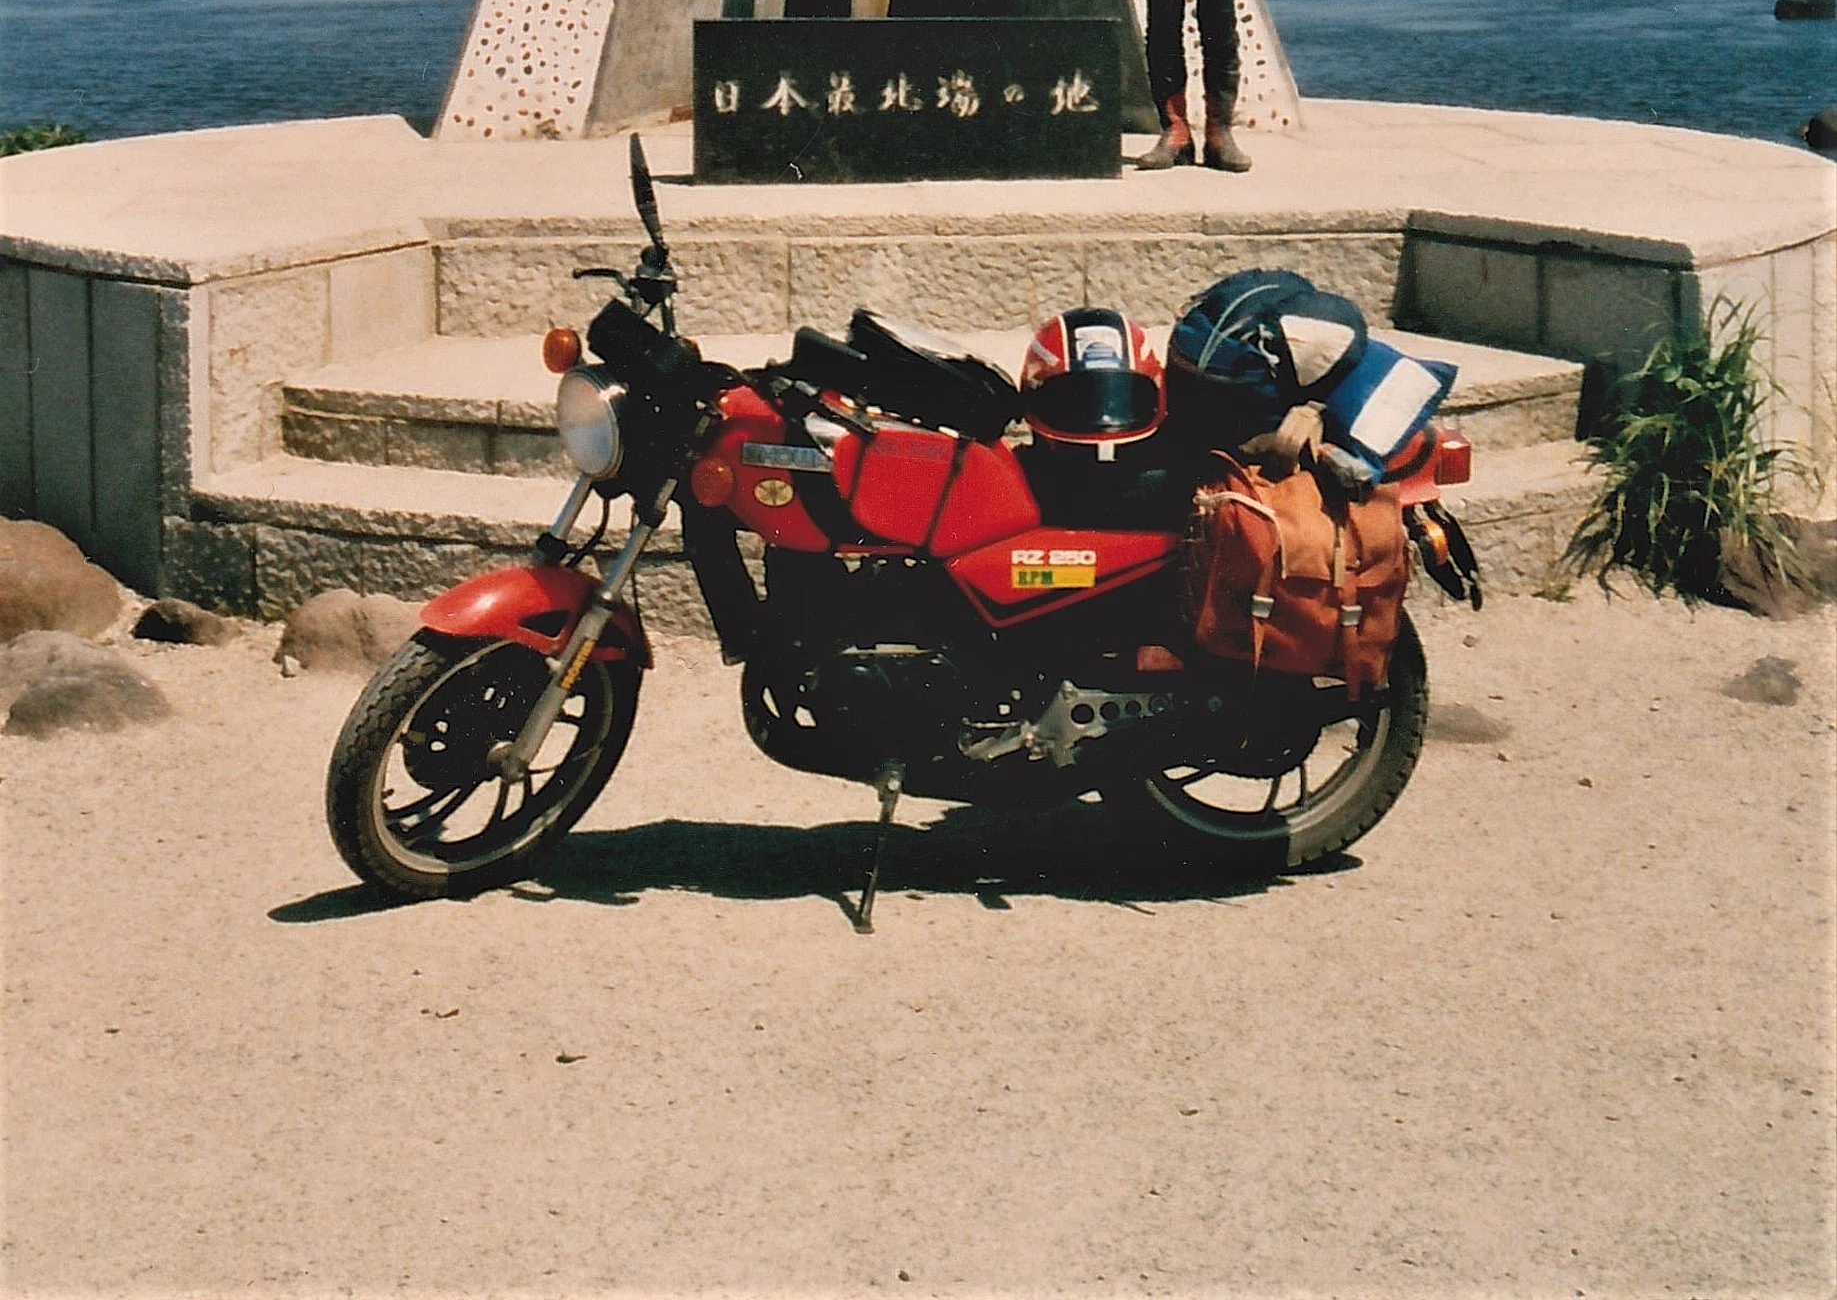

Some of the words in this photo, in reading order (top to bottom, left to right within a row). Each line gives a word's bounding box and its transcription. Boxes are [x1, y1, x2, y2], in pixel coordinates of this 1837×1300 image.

[714, 68, 1100, 118] 日本最北端の地
[1011, 550, 1044, 566] RZ
[1048, 550, 1097, 566] 250
[1018, 571, 1054, 586] RPM
